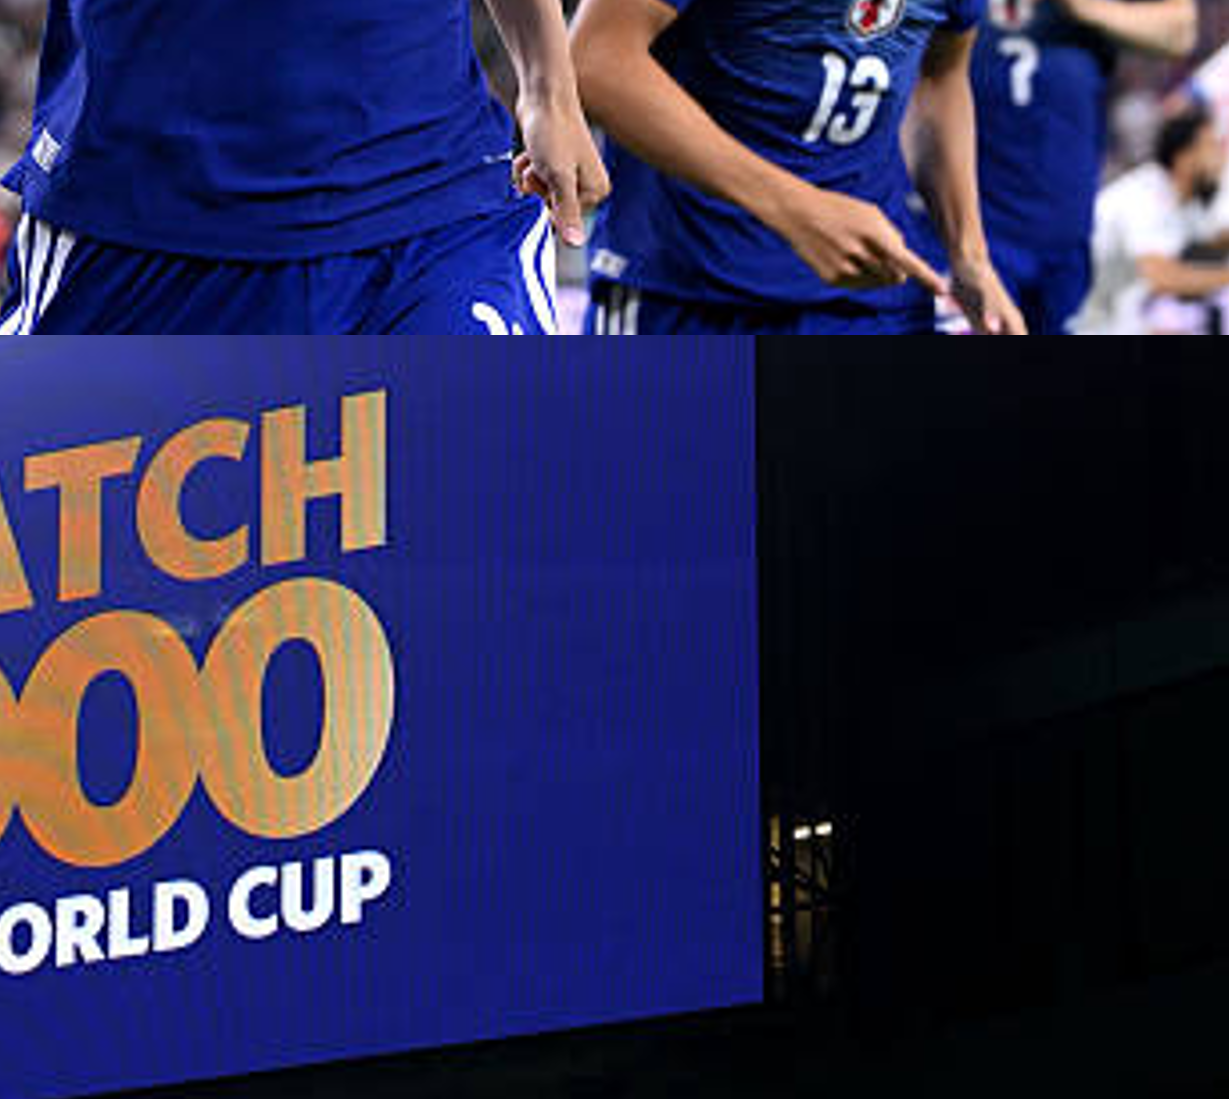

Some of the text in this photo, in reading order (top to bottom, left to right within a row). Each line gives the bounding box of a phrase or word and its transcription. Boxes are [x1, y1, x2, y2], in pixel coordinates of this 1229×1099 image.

[803, 52, 890, 145] 13
[998, 36, 1038, 107] 7
[227, 850, 391, 939] CUP
